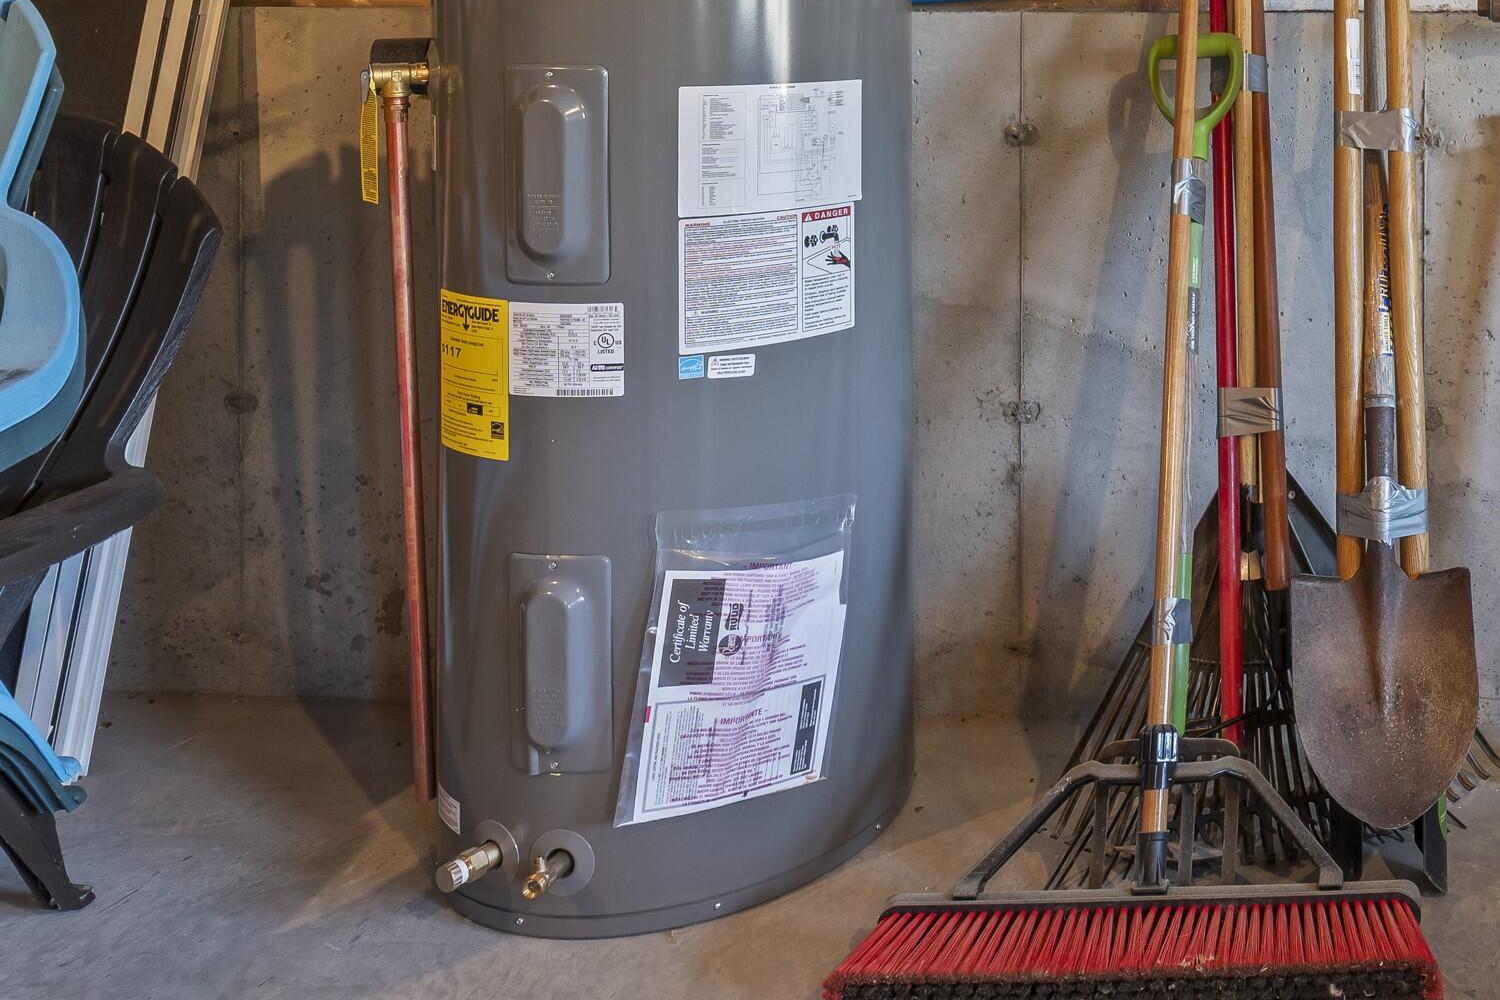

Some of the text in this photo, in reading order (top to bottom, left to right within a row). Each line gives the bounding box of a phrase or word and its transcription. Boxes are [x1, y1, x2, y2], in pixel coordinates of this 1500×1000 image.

[814, 208, 849, 220] DANGER
[442, 299, 500, 324] ENERGYGUIDE
[749, 561, 792, 571] IMPORTANT
[697, 609, 714, 652] Warranty
[729, 603, 740, 631] RUUD
[669, 600, 690, 664] Certificate of
[684, 613, 700, 650] Limited
